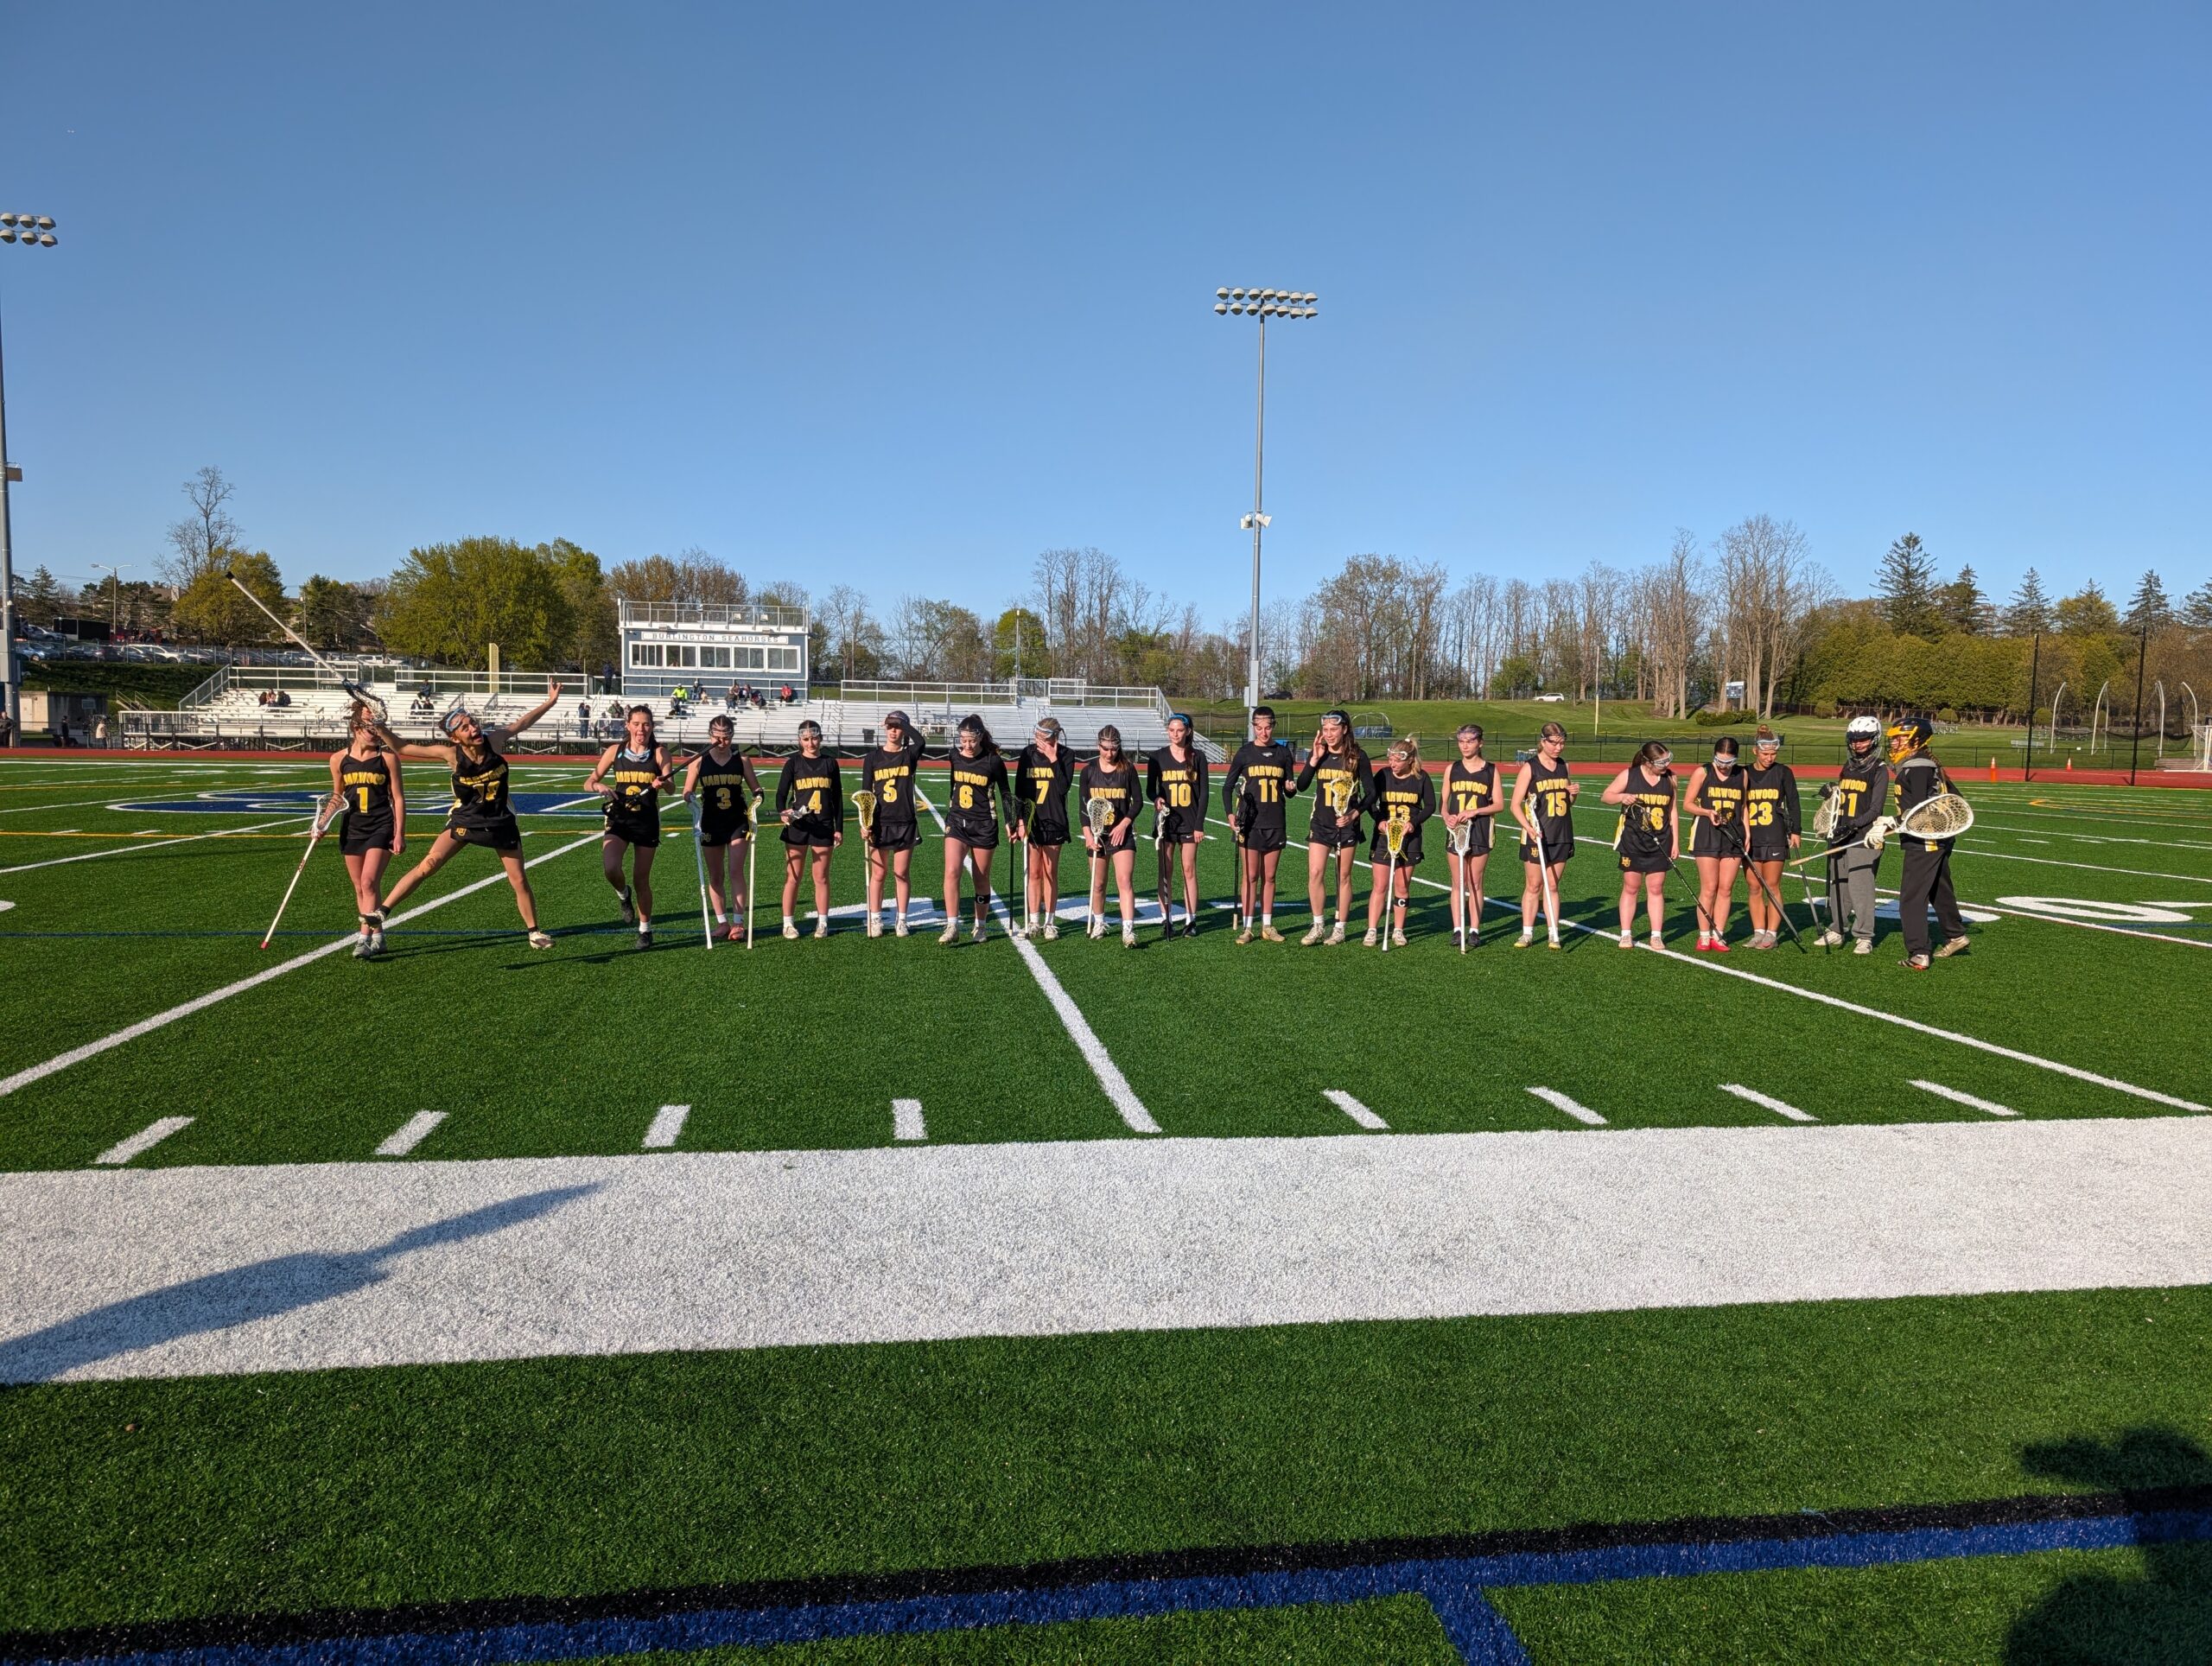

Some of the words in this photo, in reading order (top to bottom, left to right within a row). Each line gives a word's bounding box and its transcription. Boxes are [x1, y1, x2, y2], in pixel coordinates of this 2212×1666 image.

[652, 632, 715, 640] BURLINGTON
[721, 634, 779, 643] SEAHORSES
[357, 786, 368, 813] 1
[716, 787, 731, 810] 3
[808, 790, 822, 814] 4
[883, 779, 897, 803] 5
[959, 785, 973, 809] 6
[1036, 780, 1049, 804] 7
[1168, 783, 1192, 807] 10
[1259, 778, 1278, 803] 11
[1747, 788, 1780, 800] RWOOD
[1388, 804, 1411, 822] 13
[1457, 793, 1478, 813] 14
[1545, 792, 1567, 817] 15
[1748, 801, 1773, 826] 23
[976, 895, 985, 904] C
[1397, 899, 1406, 907] C
